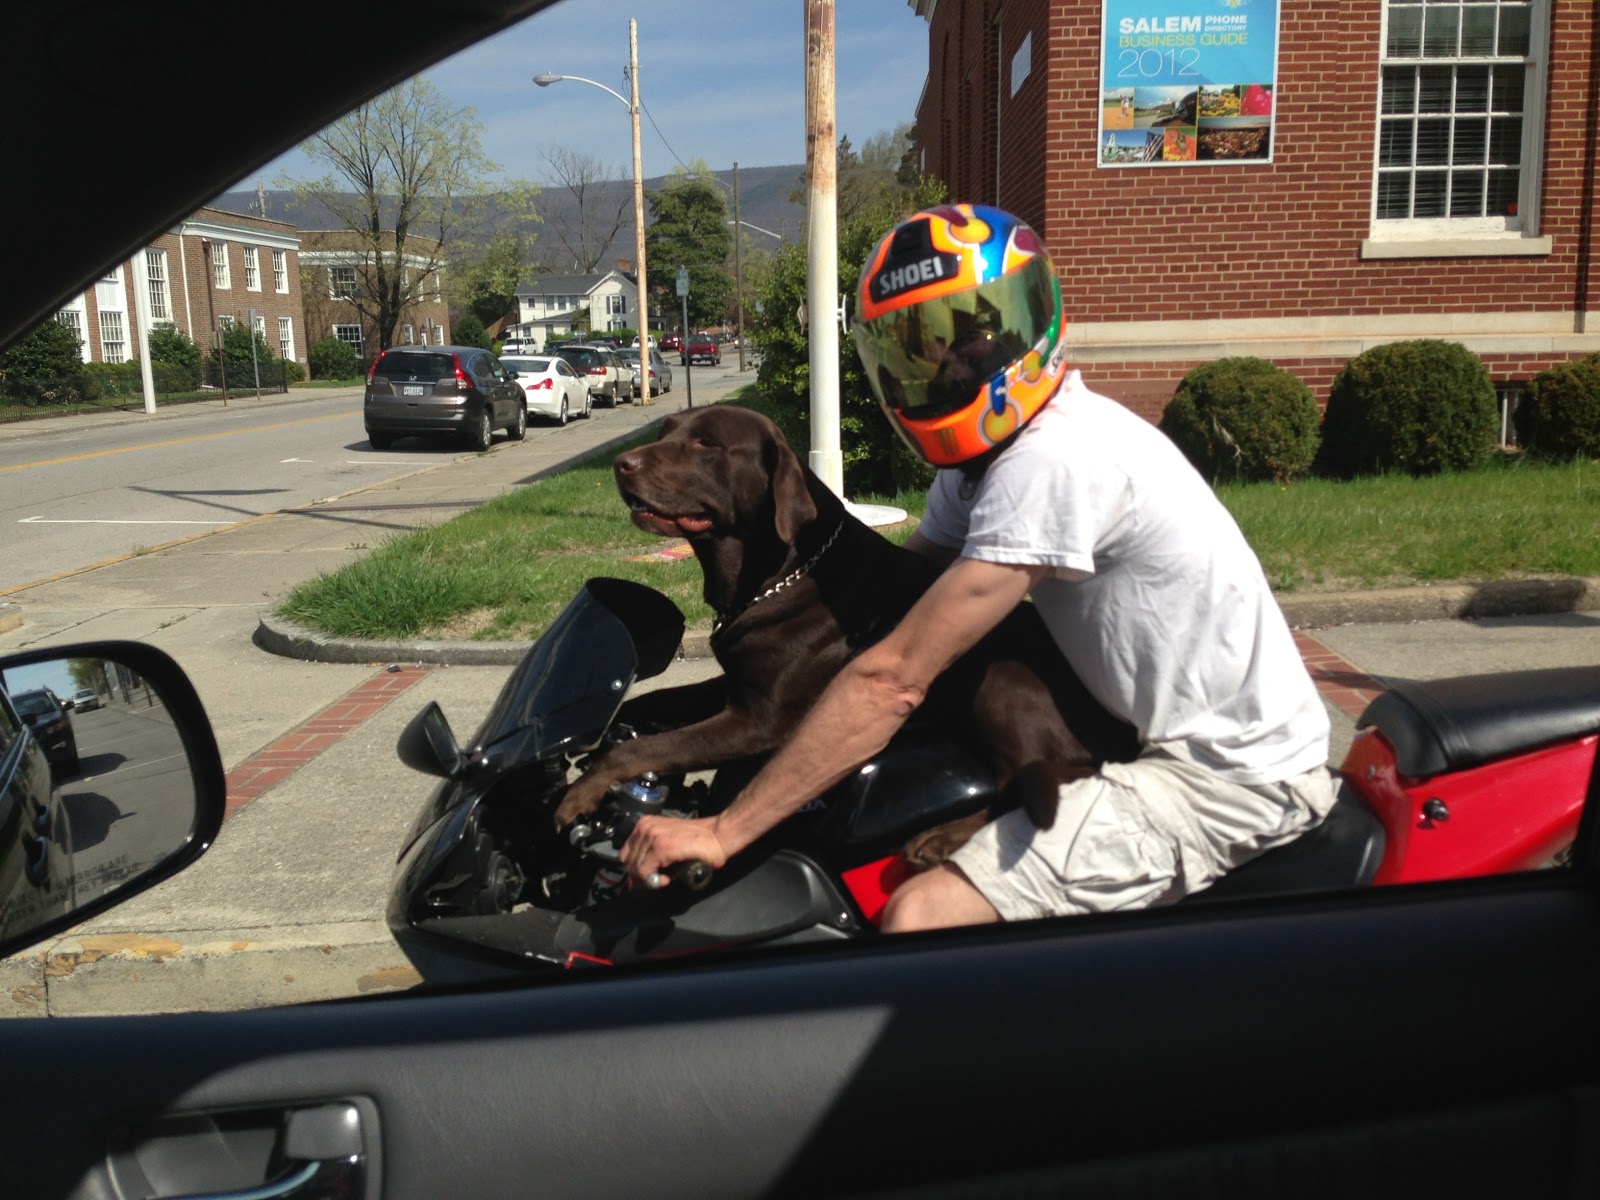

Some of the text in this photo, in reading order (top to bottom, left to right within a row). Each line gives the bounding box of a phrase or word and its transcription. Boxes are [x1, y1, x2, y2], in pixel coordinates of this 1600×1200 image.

[1119, 15, 1248, 33] SALEM PHONE
[1119, 32, 1248, 48] BUSINESS GUIDE
[1118, 47, 1200, 77] 2012
[879, 256, 943, 295] SHOEI
